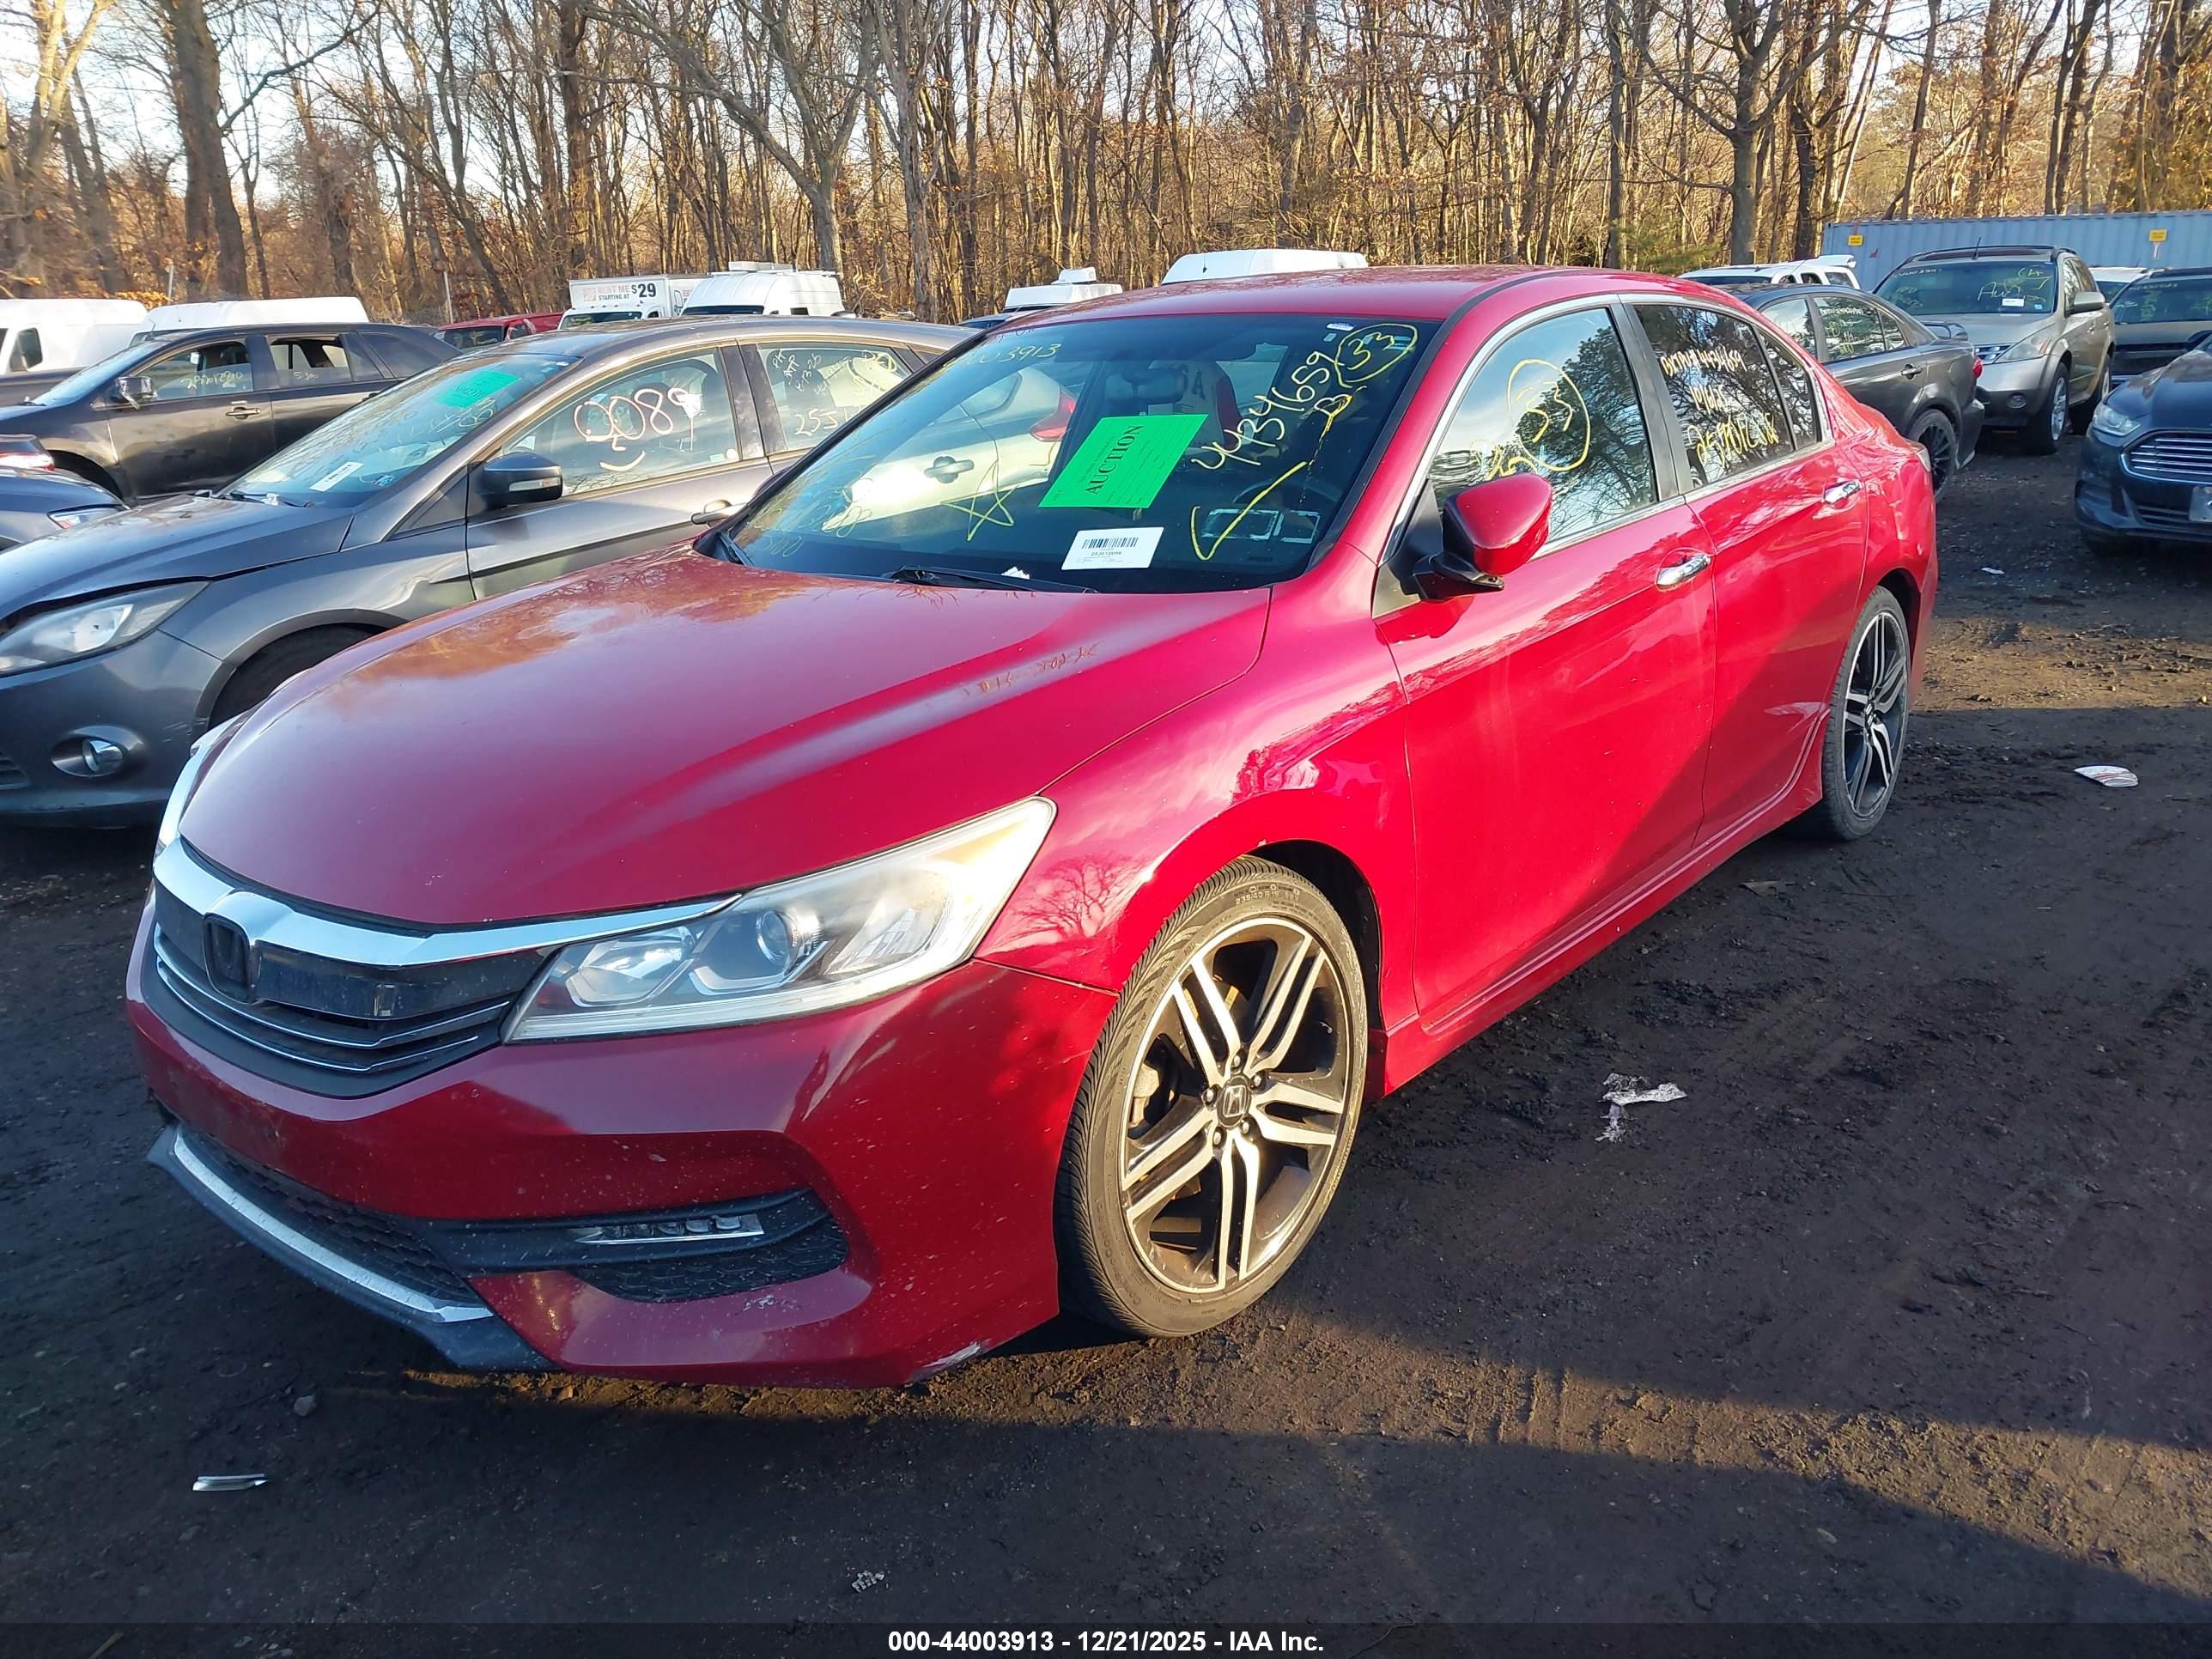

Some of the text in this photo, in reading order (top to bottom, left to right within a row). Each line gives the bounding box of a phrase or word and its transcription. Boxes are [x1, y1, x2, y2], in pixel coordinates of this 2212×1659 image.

[598, 283, 656, 298] RENT ME $29
[1085, 424, 1146, 495] AUCTION
